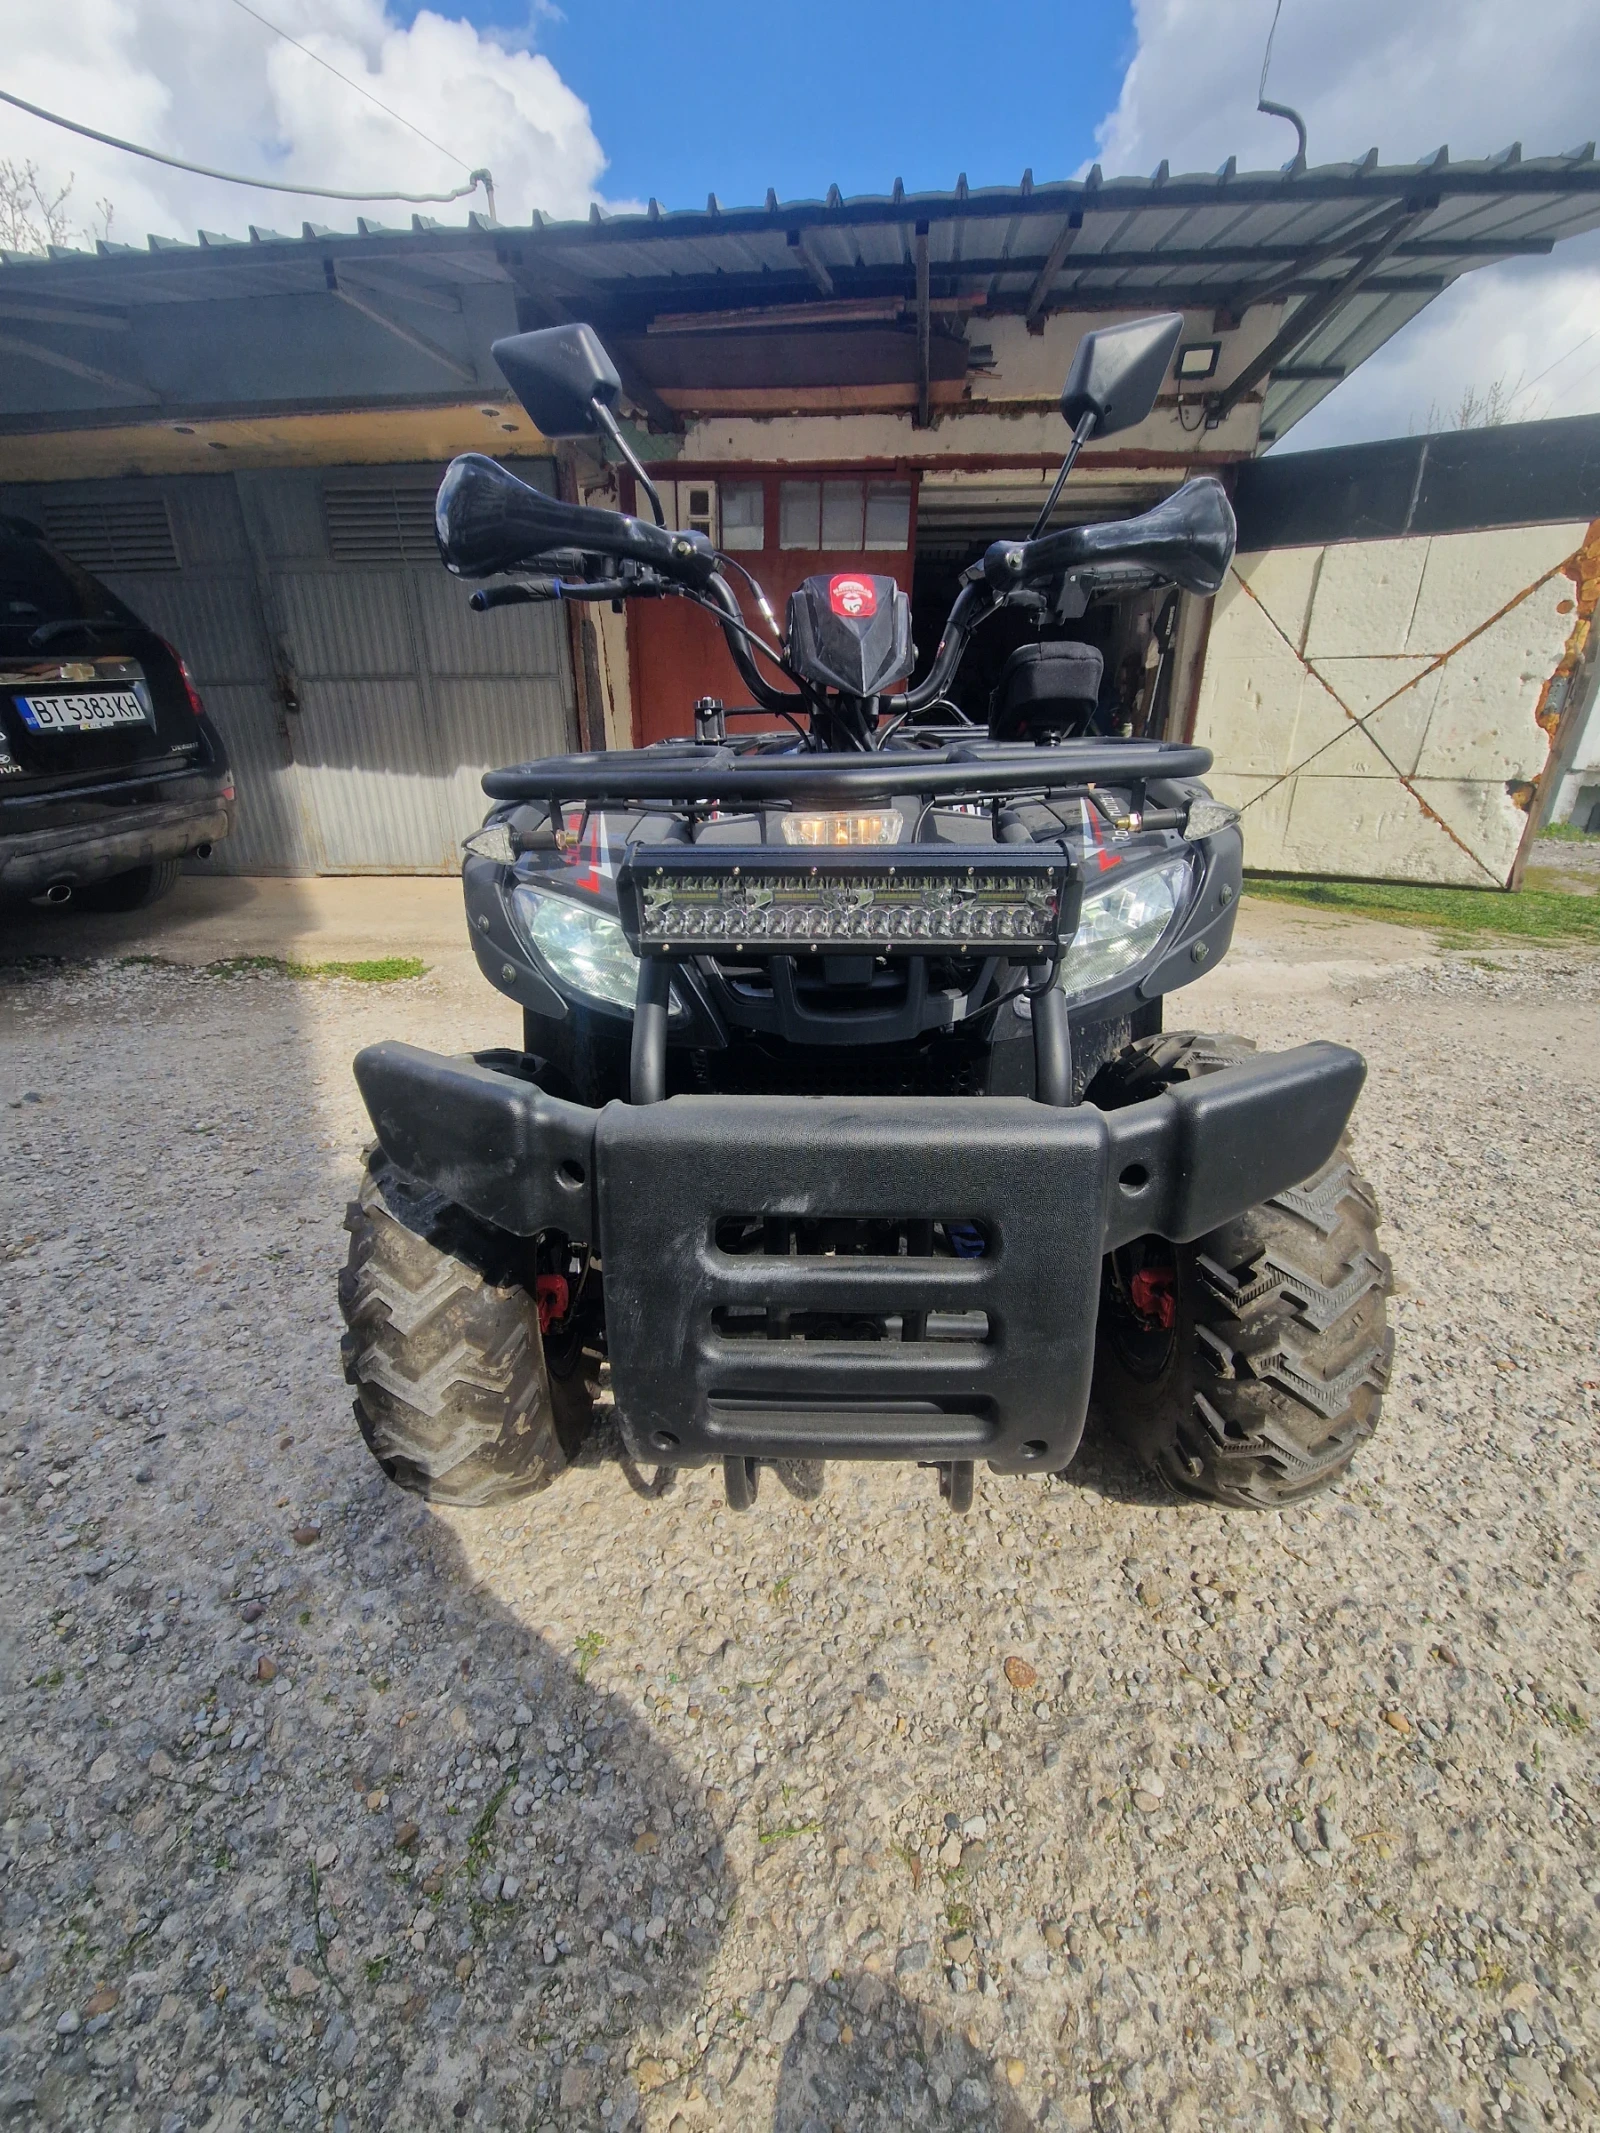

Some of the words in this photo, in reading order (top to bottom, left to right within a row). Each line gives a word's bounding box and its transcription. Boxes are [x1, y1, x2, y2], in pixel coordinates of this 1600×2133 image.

[31, 699, 65, 725] BT
[64, 696, 115, 721] 5383
[112, 695, 141, 718] KH
